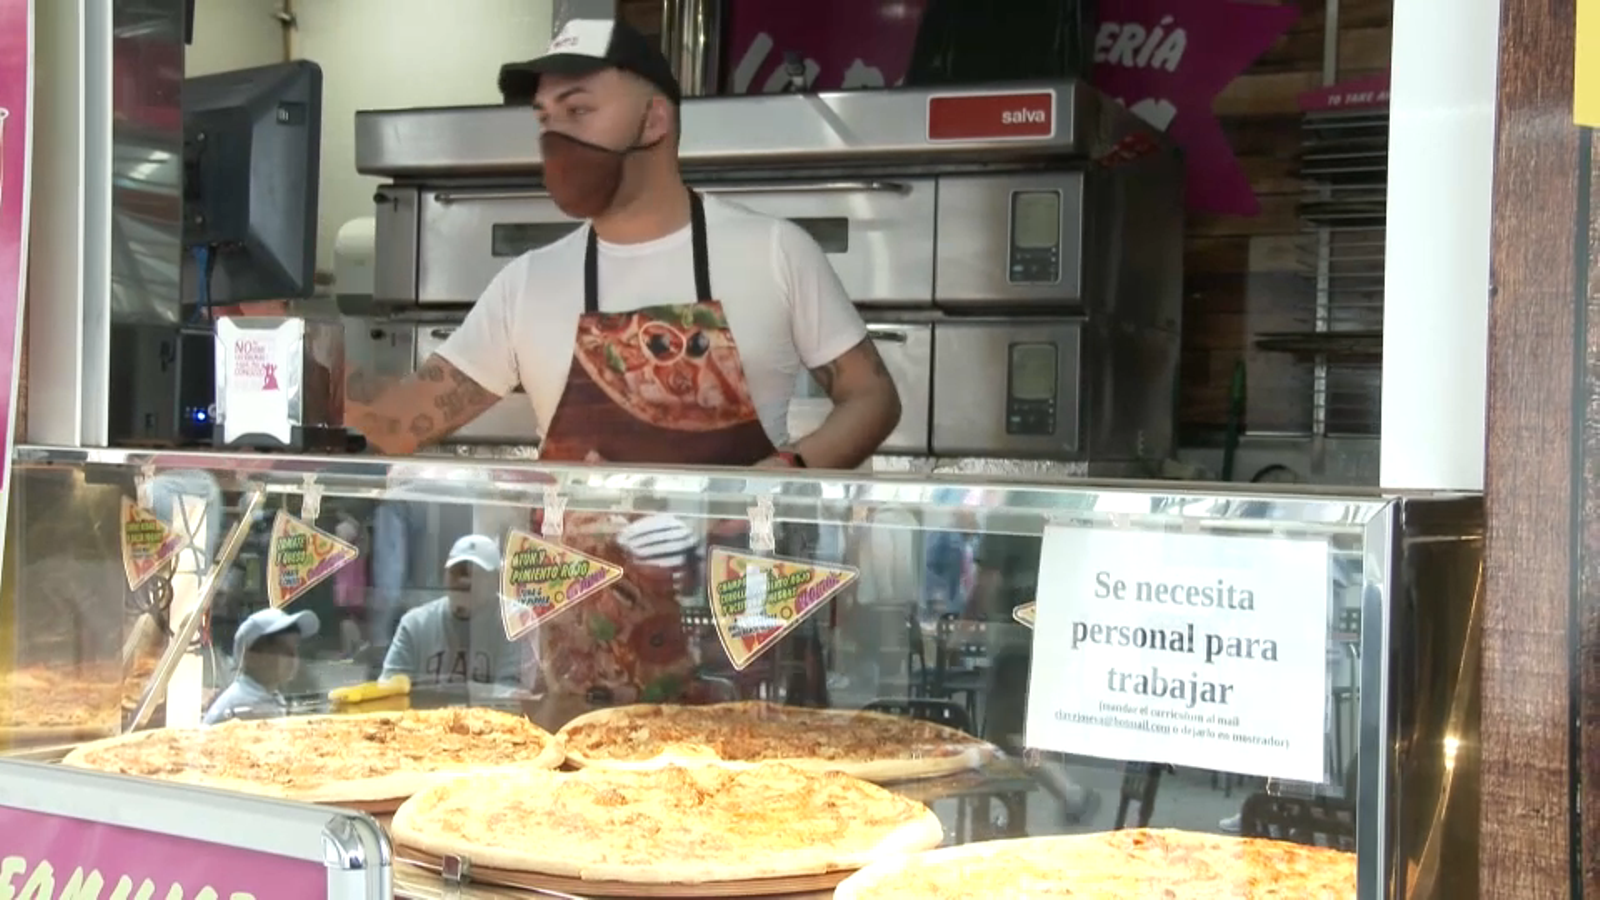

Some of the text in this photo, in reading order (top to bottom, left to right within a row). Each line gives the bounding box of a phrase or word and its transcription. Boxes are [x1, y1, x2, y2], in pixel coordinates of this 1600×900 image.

[1094, 14, 1188, 73] ERÍA
[1002, 108, 1045, 124] salva
[1345, 91, 1374, 105] TAKE
[511, 564, 559, 585] PIMIENTO
[560, 561, 589, 580] ROJO
[1094, 570, 1255, 611] Se necesita
[1071, 620, 1278, 663] personal para
[1107, 666, 1233, 708] trabajar
